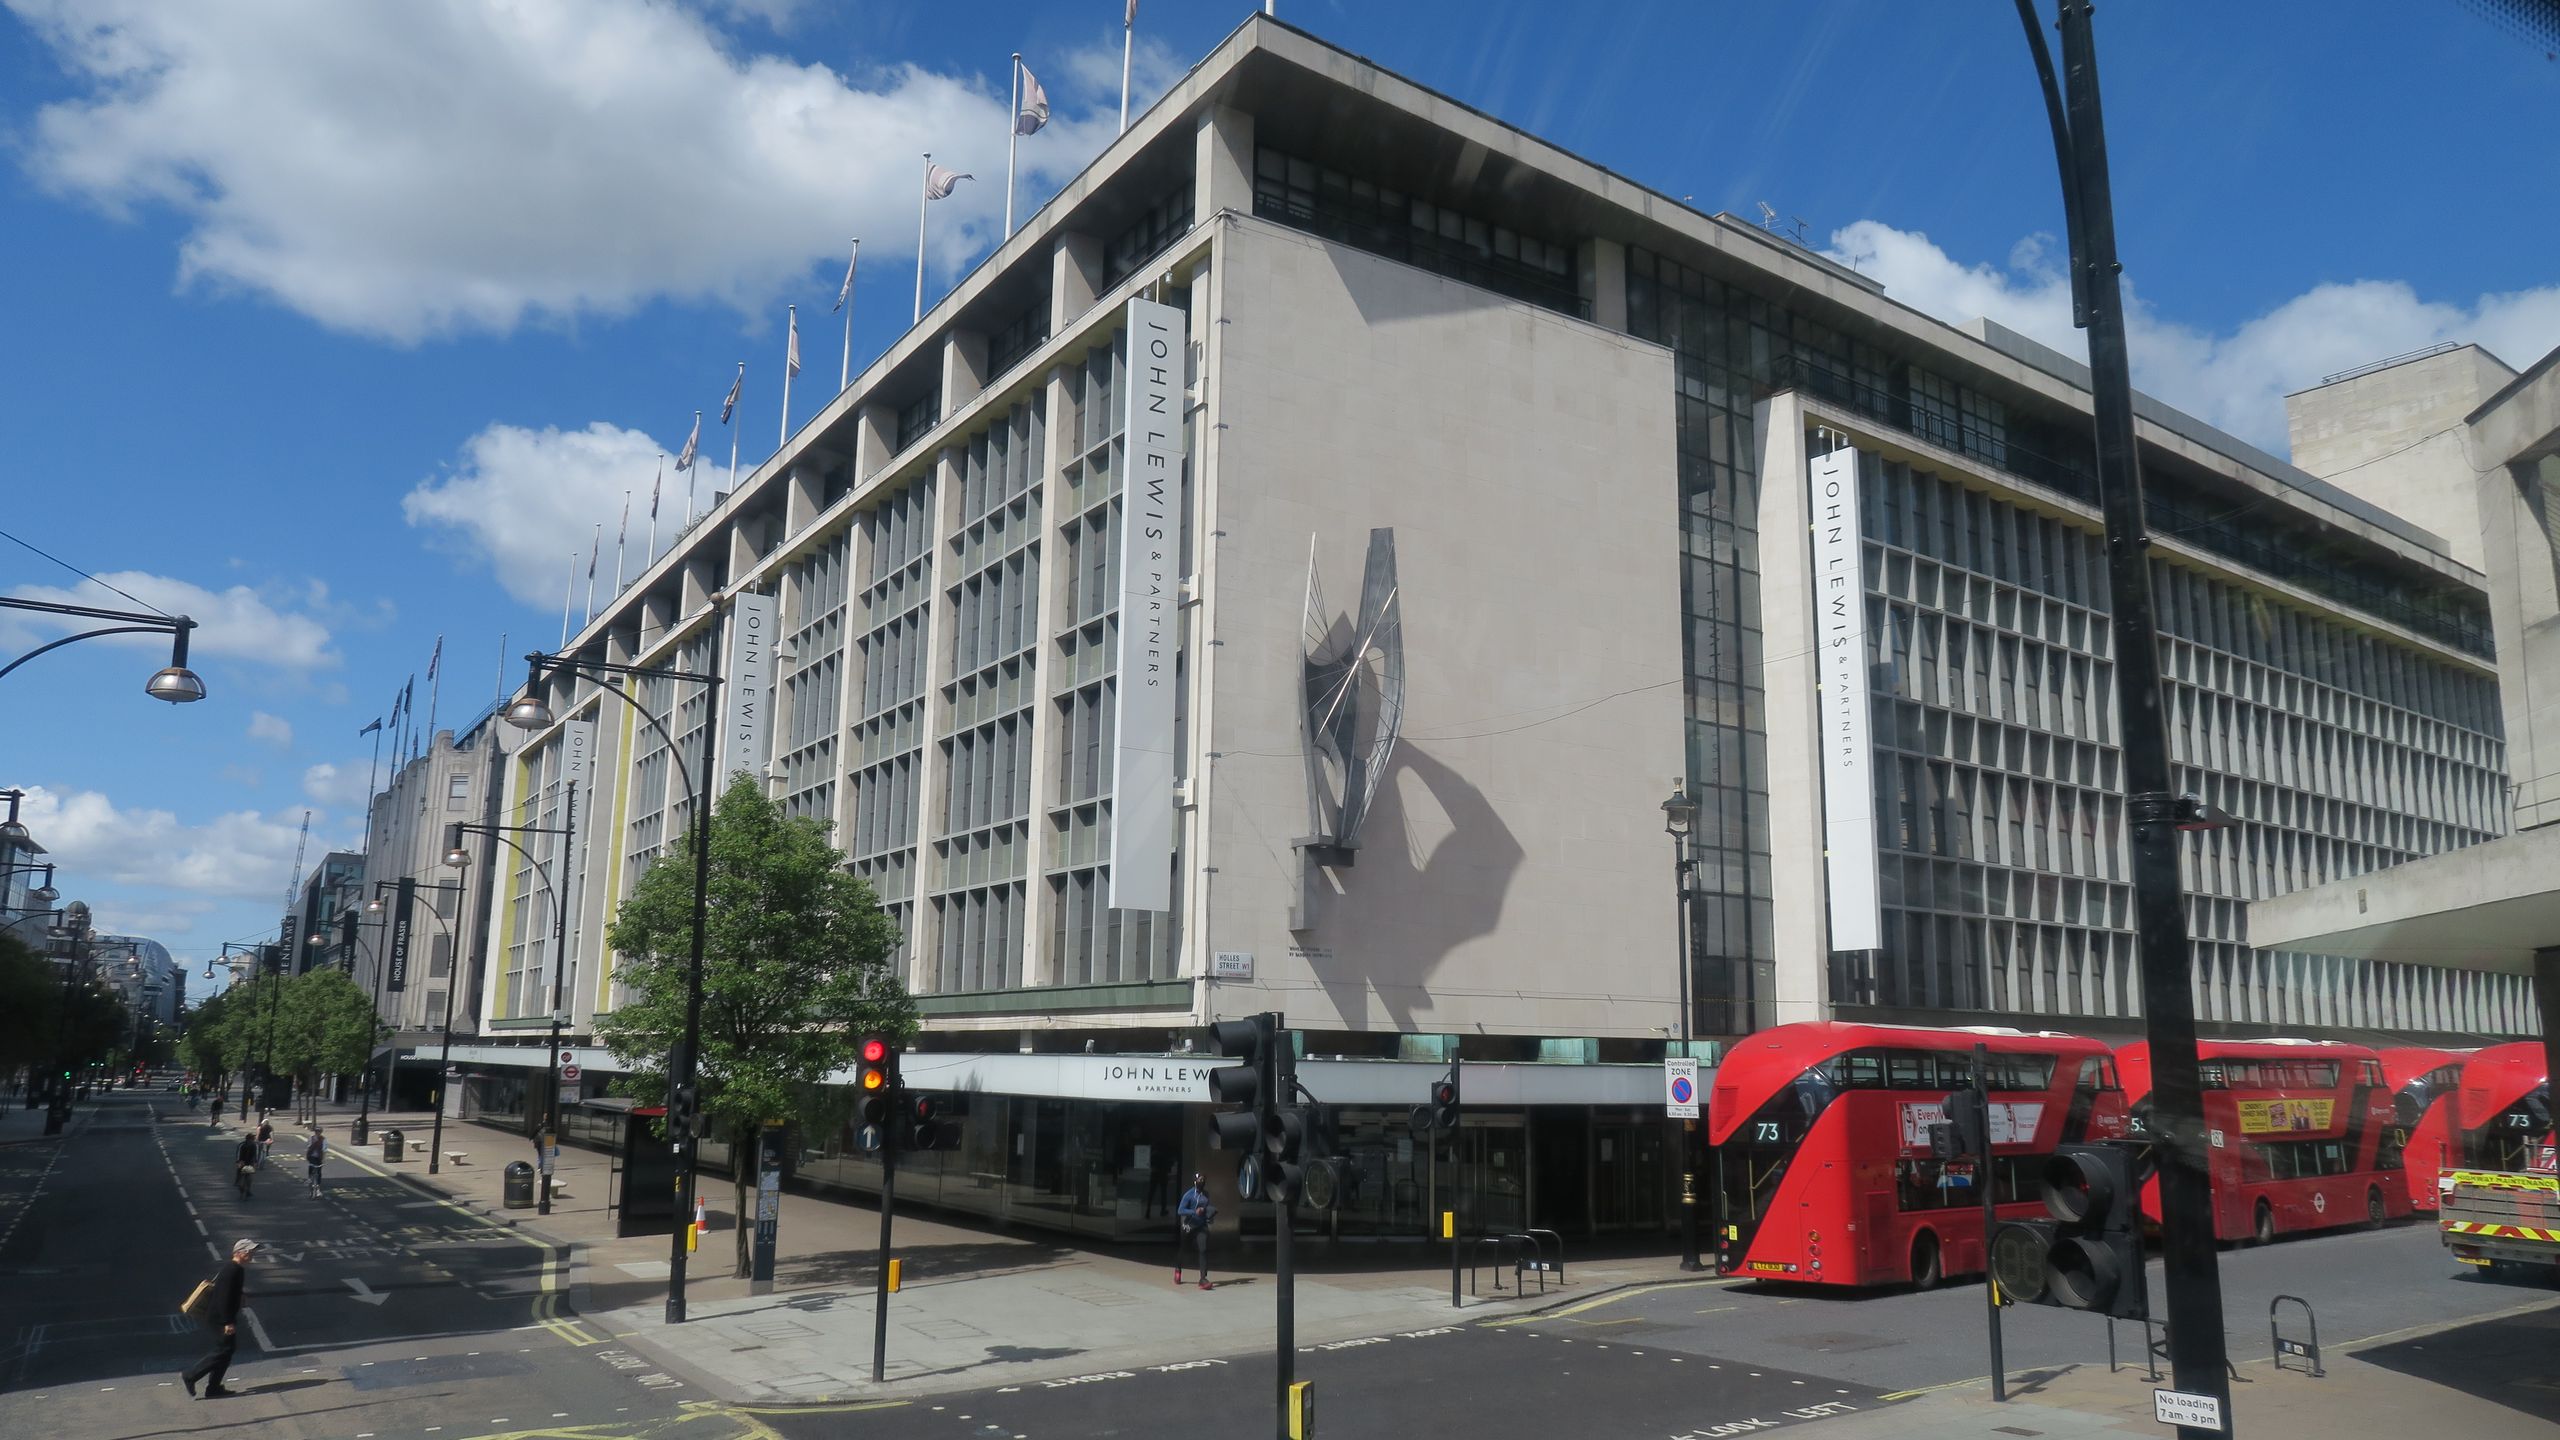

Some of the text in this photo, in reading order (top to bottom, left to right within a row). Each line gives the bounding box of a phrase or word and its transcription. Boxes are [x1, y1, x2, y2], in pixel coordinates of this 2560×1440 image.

[1145, 321, 1168, 687] JOHN LEWIS & PARTNERS
[1823, 468, 1853, 768] JOHN LEWIS & PARTNERS
[746, 606, 761, 664] JOHN
[740, 674, 756, 741] LEWIS
[571, 729, 584, 771] JOHN
[397, 920, 407, 944] FRASER
[280, 918, 295, 975] BENHAMS
[1219, 954, 1240, 962] HOLLES
[393, 956, 404, 981] HOUSE
[1219, 962, 1239, 970] STREET
[1104, 1066, 1210, 1080] JOHN LEW
[1757, 1123, 1779, 1141] 73
[2509, 1115, 2530, 1127] 73
[2456, 1174, 2555, 1187] HIGHWAY MAINTENANCE
[1322, 1325, 1466, 1350] LOOK RIGHT
[1041, 1358, 1228, 1388] LOOK RIGHT
[2158, 1394, 2215, 1412] No loading
[1693, 1401, 1858, 1437] LOOK LEFT
[2160, 1408, 2166, 1417] 7
[2168, 1411, 2184, 1420] am
[2191, 1412, 2198, 1422] 9
[2200, 1414, 2217, 1425] pm
